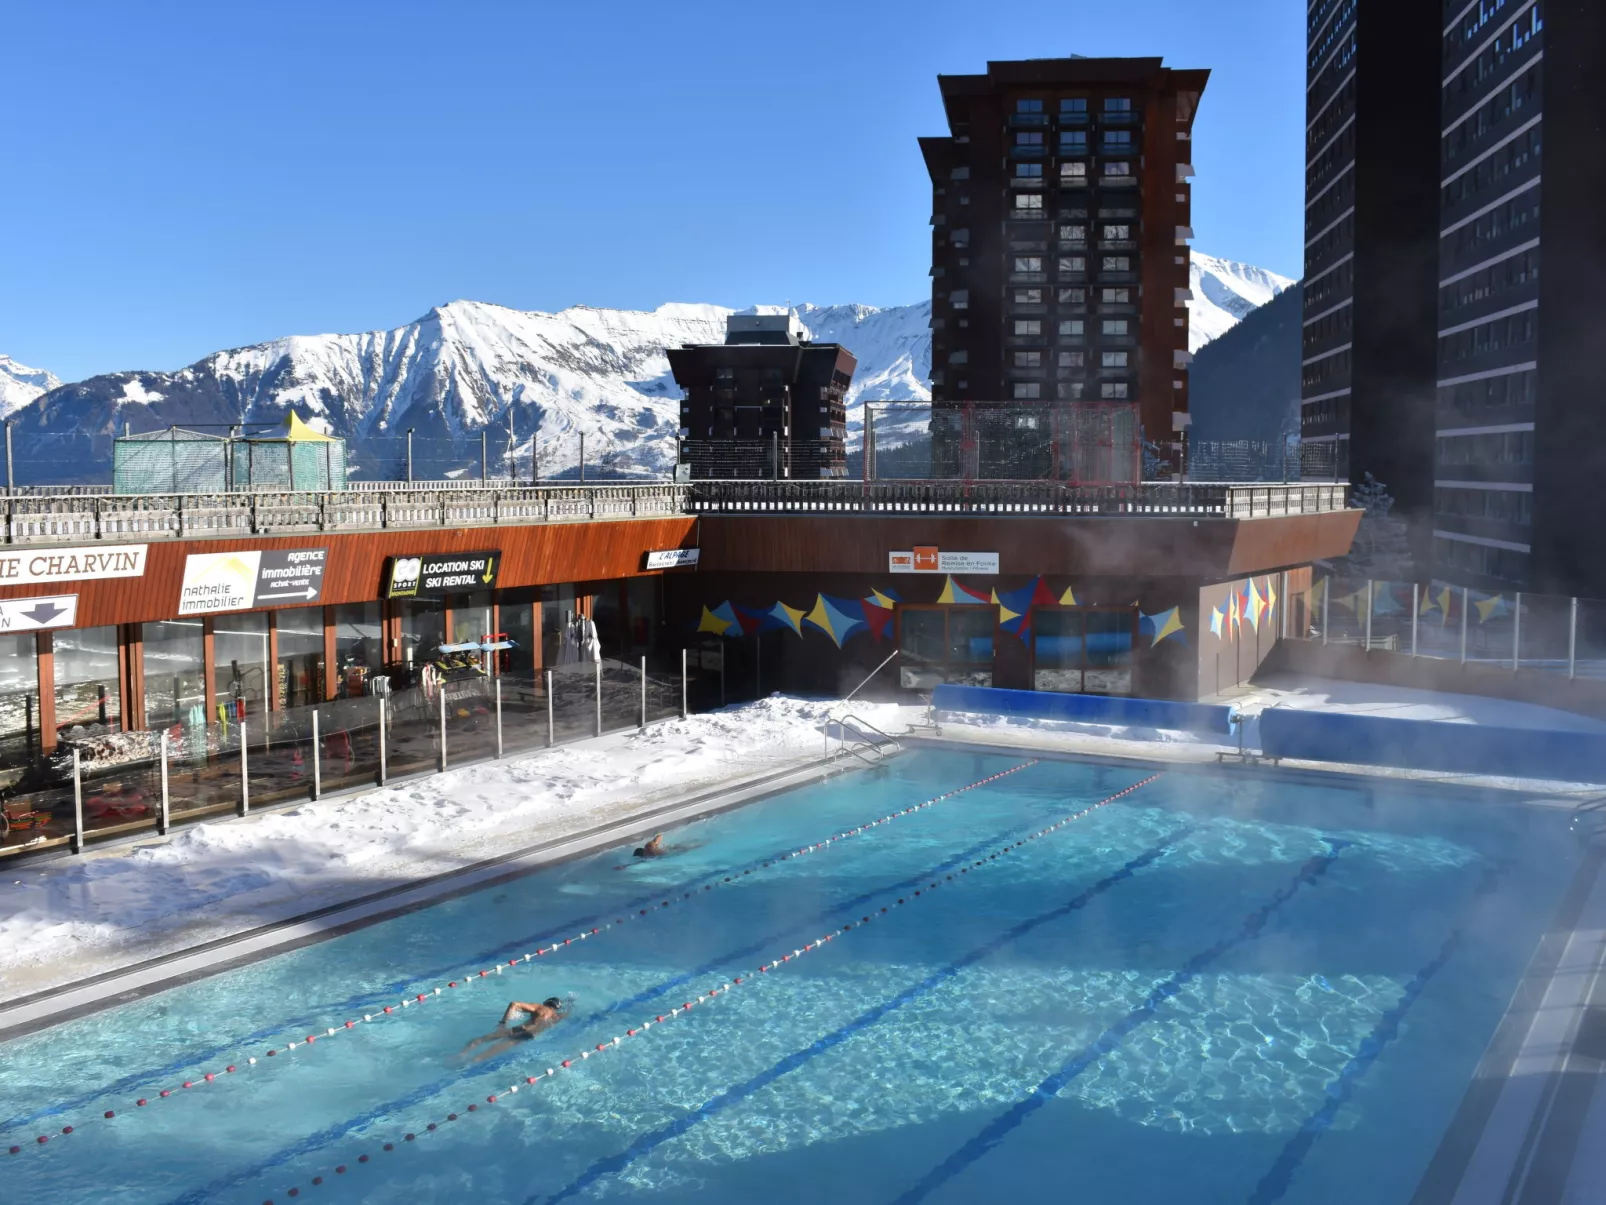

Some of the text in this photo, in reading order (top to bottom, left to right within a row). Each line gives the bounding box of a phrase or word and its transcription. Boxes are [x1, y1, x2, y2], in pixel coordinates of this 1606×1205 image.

[29, 552, 140, 576] CHARVIN
[261, 564, 323, 579] immobilière
[423, 560, 485, 574] LOCATION SKI
[425, 574, 477, 588] SKI RENTAL
[182, 596, 244, 611] immobilier
